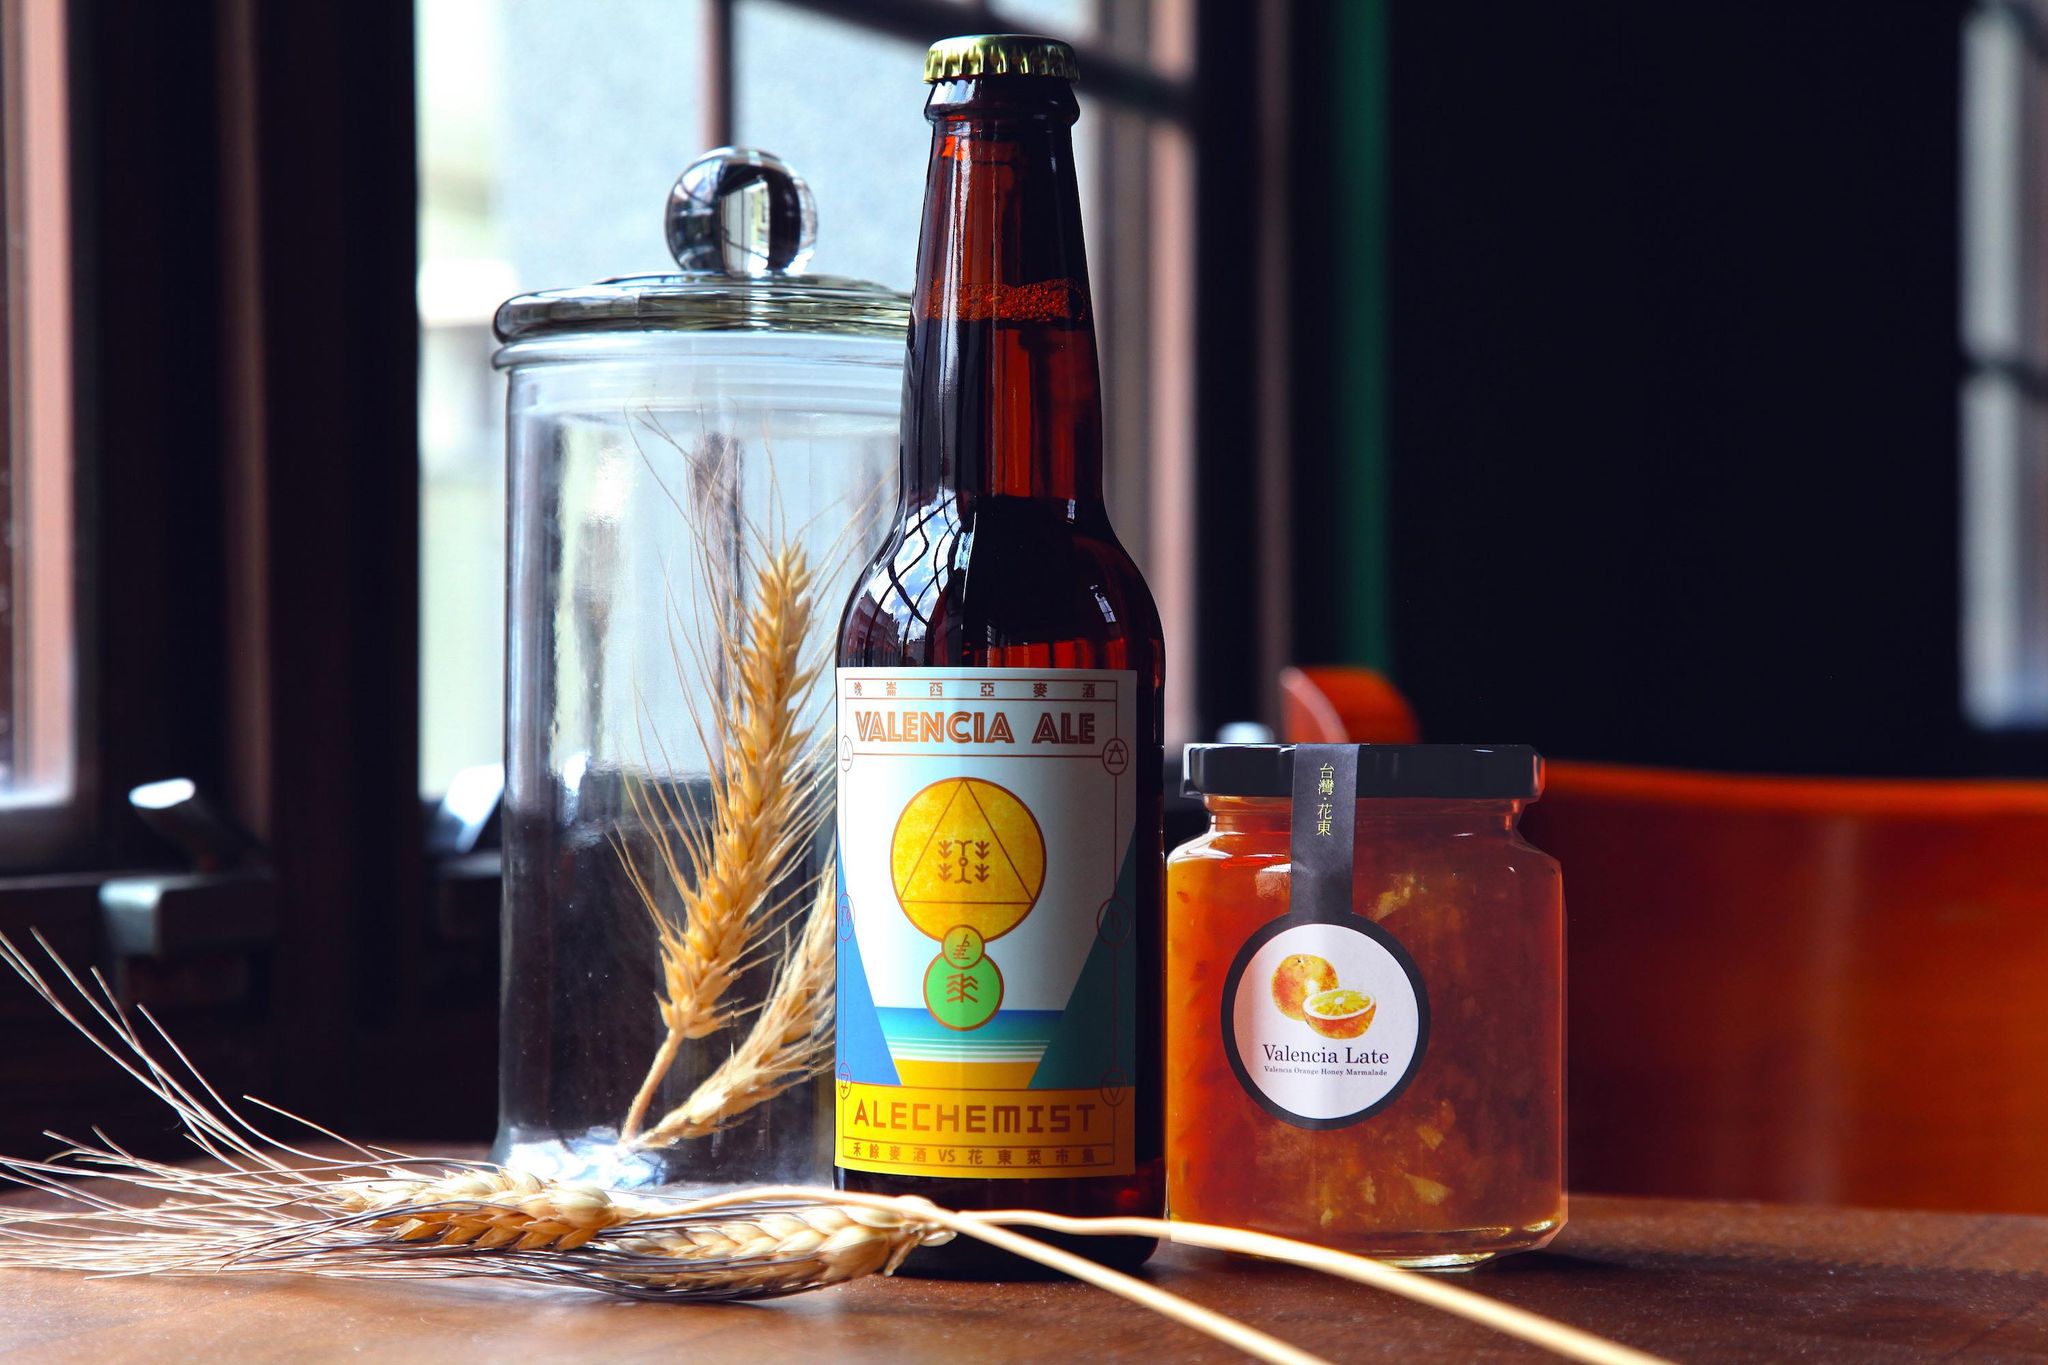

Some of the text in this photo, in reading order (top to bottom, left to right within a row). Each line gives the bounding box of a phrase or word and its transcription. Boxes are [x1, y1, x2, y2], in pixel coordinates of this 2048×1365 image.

[854, 710, 1096, 746] VALENCIA ALE
[1262, 1043, 1389, 1064] Valencia Late
[1321, 1068, 1343, 1076] Honey
[1346, 1068, 1387, 1076] Marmalade
[854, 1098, 1096, 1133] ALECHEMIST
[937, 1149, 956, 1164] VS
